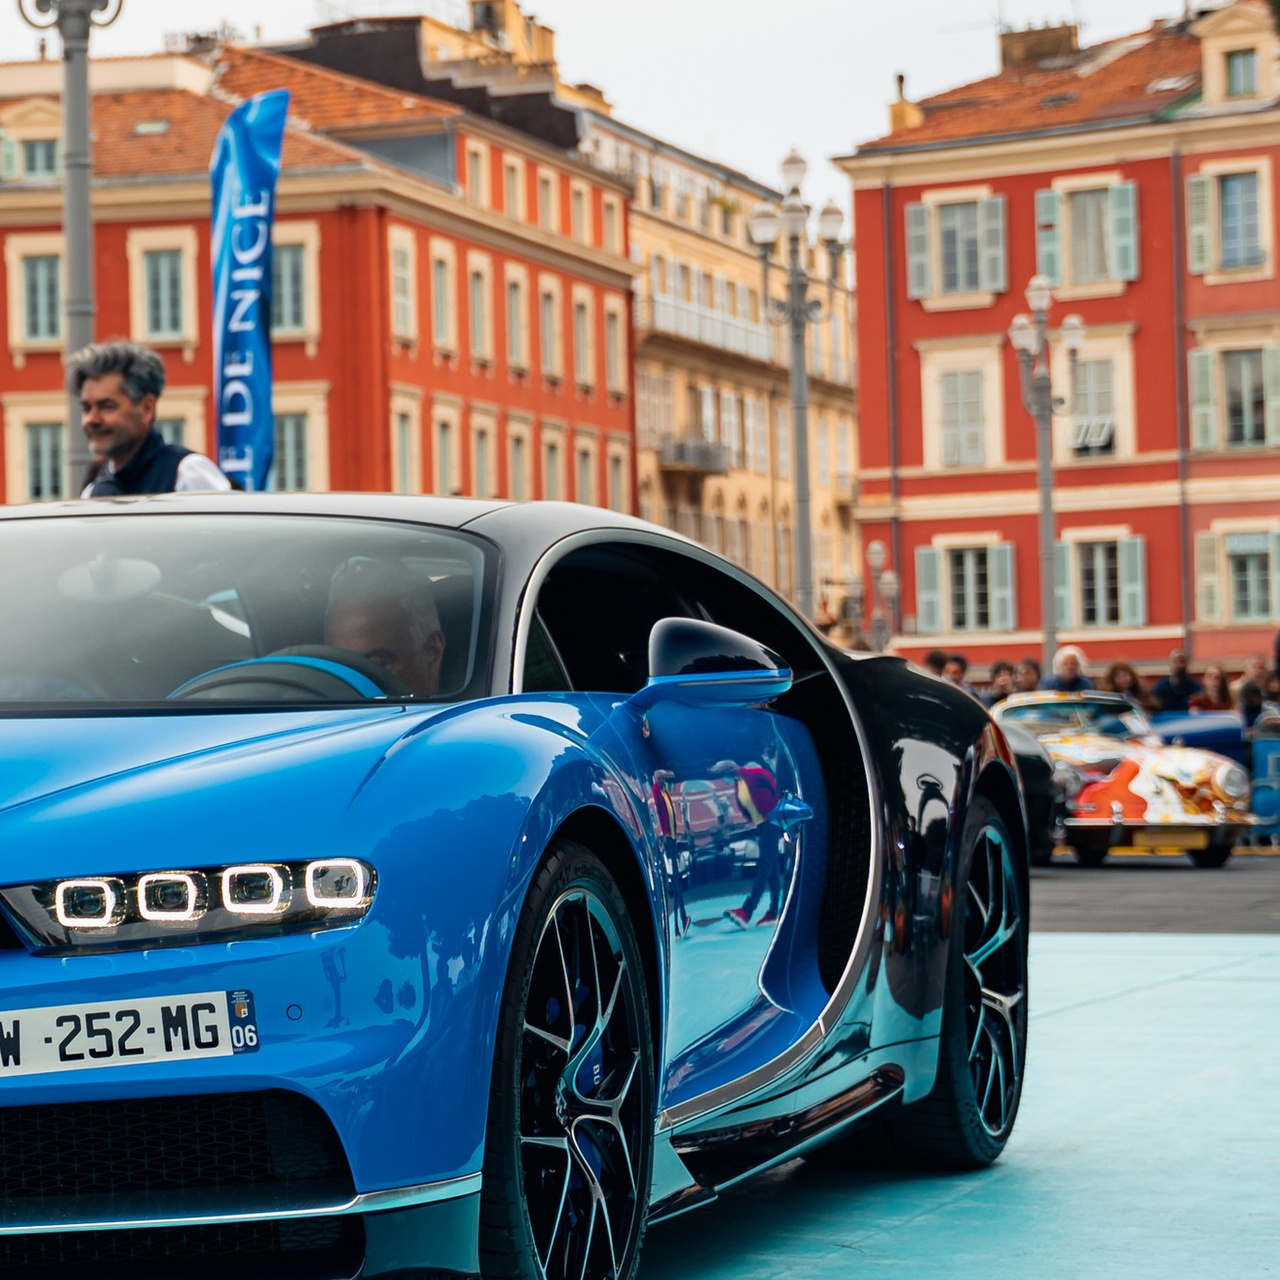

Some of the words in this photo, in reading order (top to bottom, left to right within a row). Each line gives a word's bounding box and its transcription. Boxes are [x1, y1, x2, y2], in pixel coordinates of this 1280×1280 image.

[228, 187, 271, 334] NICE
[222, 349, 255, 427] DE
[231, 1024, 258, 1048] 06
